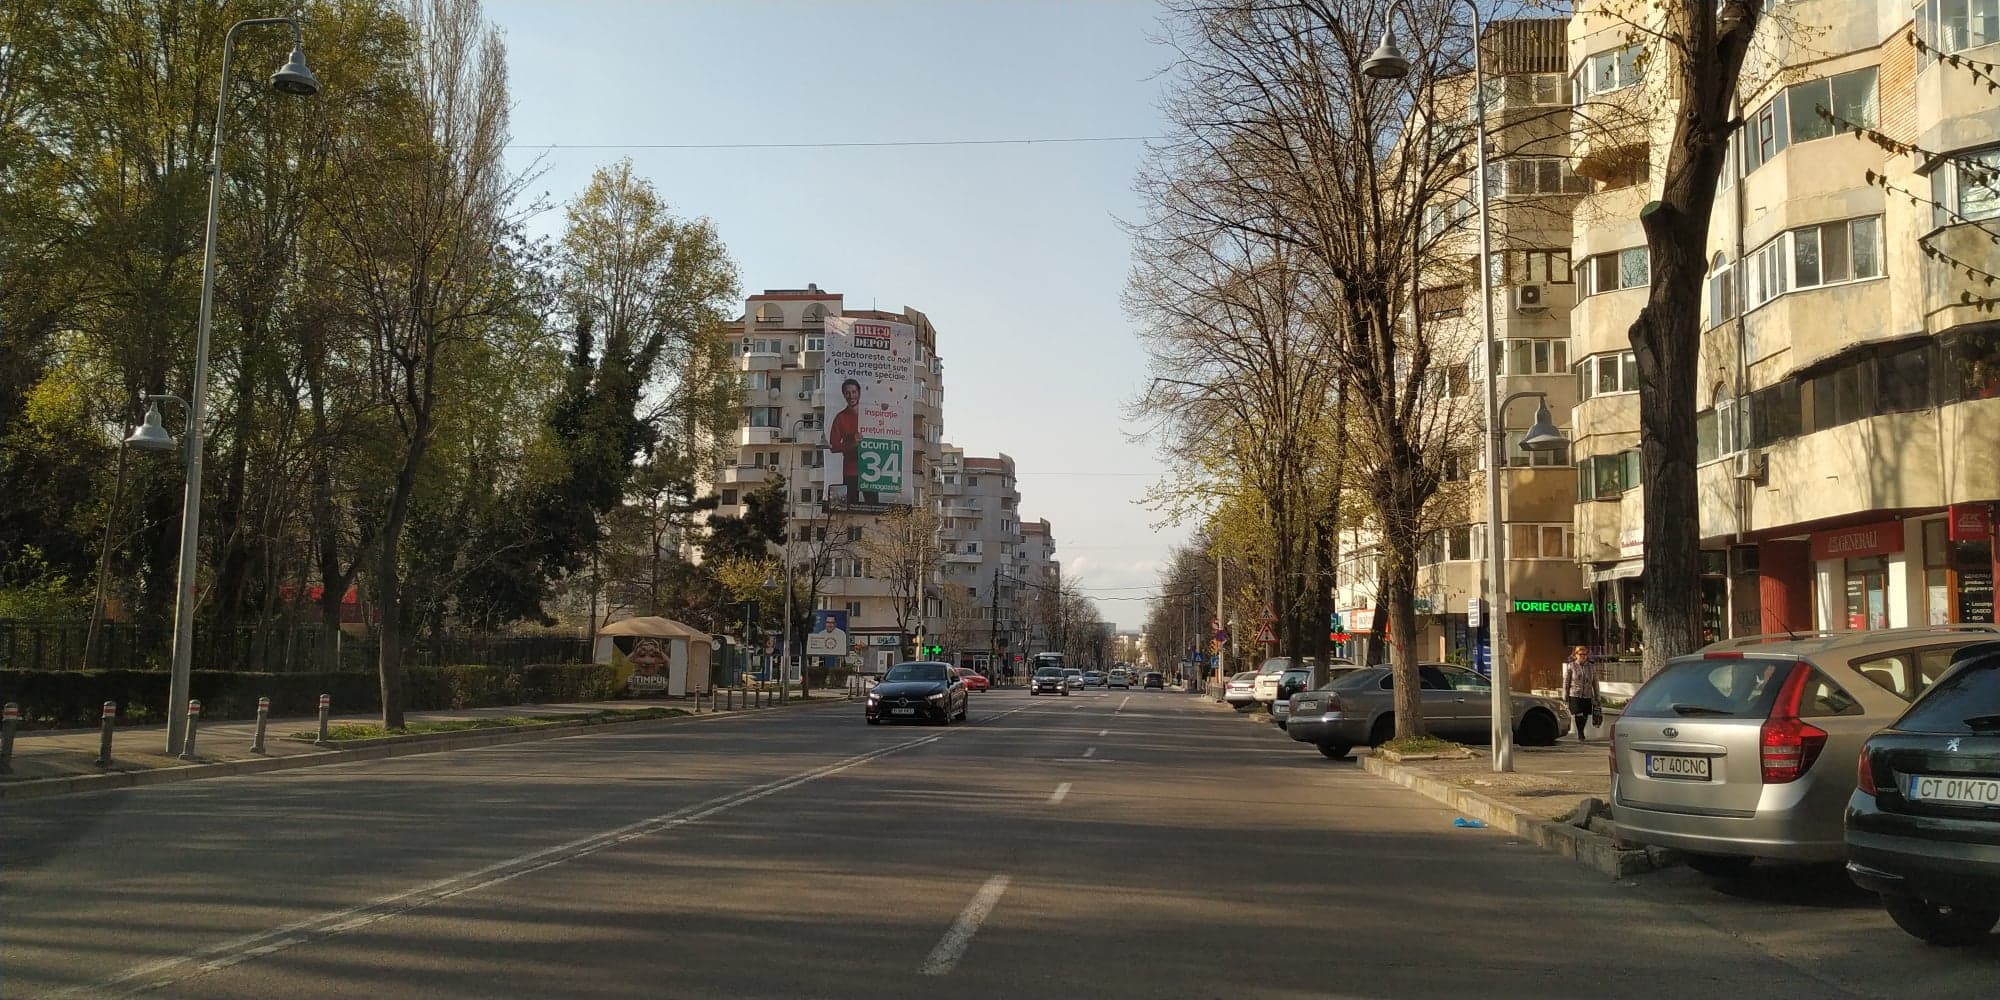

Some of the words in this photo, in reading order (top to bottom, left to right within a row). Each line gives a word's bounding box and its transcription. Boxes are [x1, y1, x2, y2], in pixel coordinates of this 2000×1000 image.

[855, 325, 890, 337] BRICO
[834, 367, 846, 375] de
[847, 368, 873, 377] oferte
[886, 428, 901, 436] mici
[860, 440, 889, 450] acum
[860, 451, 901, 483] 34
[1839, 531, 1878, 552] GENERALI
[1652, 757, 1667, 773] CT
[1669, 758, 1707, 775] 40CNC
[1921, 779, 1942, 798] CT
[1946, 780, 1999, 801] 01KTO
